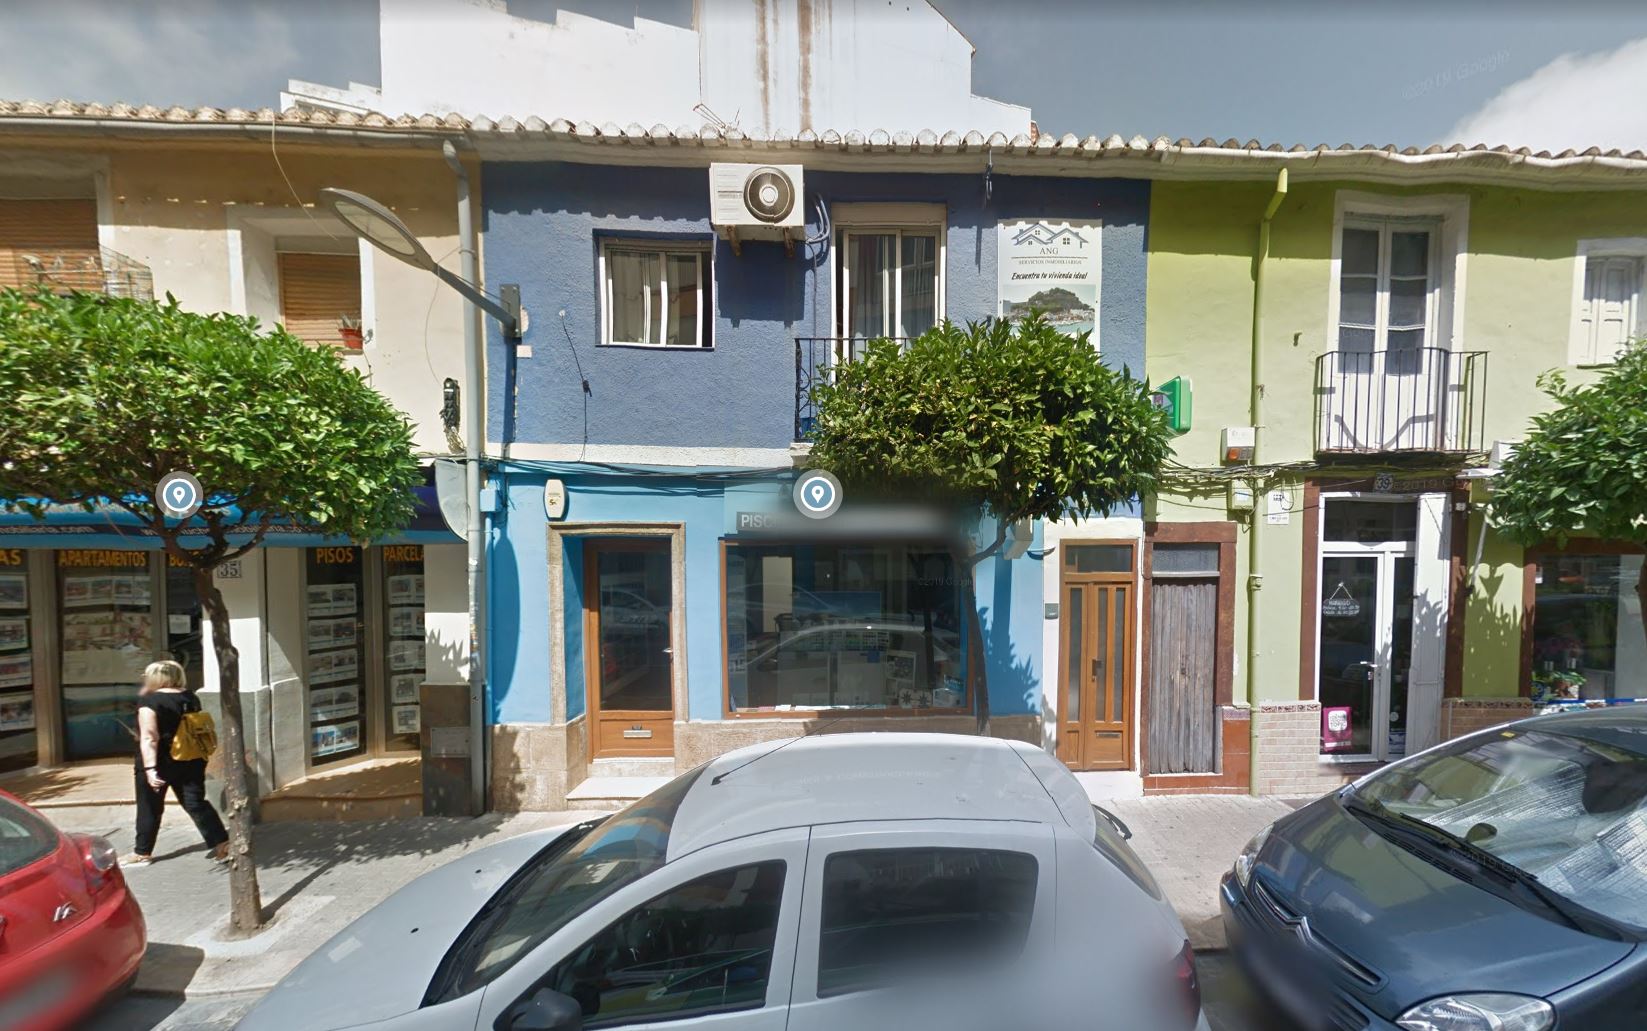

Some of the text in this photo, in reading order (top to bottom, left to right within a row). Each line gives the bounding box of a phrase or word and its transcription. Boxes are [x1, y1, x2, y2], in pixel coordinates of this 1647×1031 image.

[1039, 247, 1059, 255] ANG
[1011, 272, 1040, 280] Encuentra
[1048, 271, 1072, 279] vivienda
[1073, 271, 1088, 279] ideal
[1377, 477, 1390, 490] 39
[58, 549, 147, 568] APARTAMENTOS
[316, 547, 353, 564] PISOS
[220, 562, 239, 577] 35
